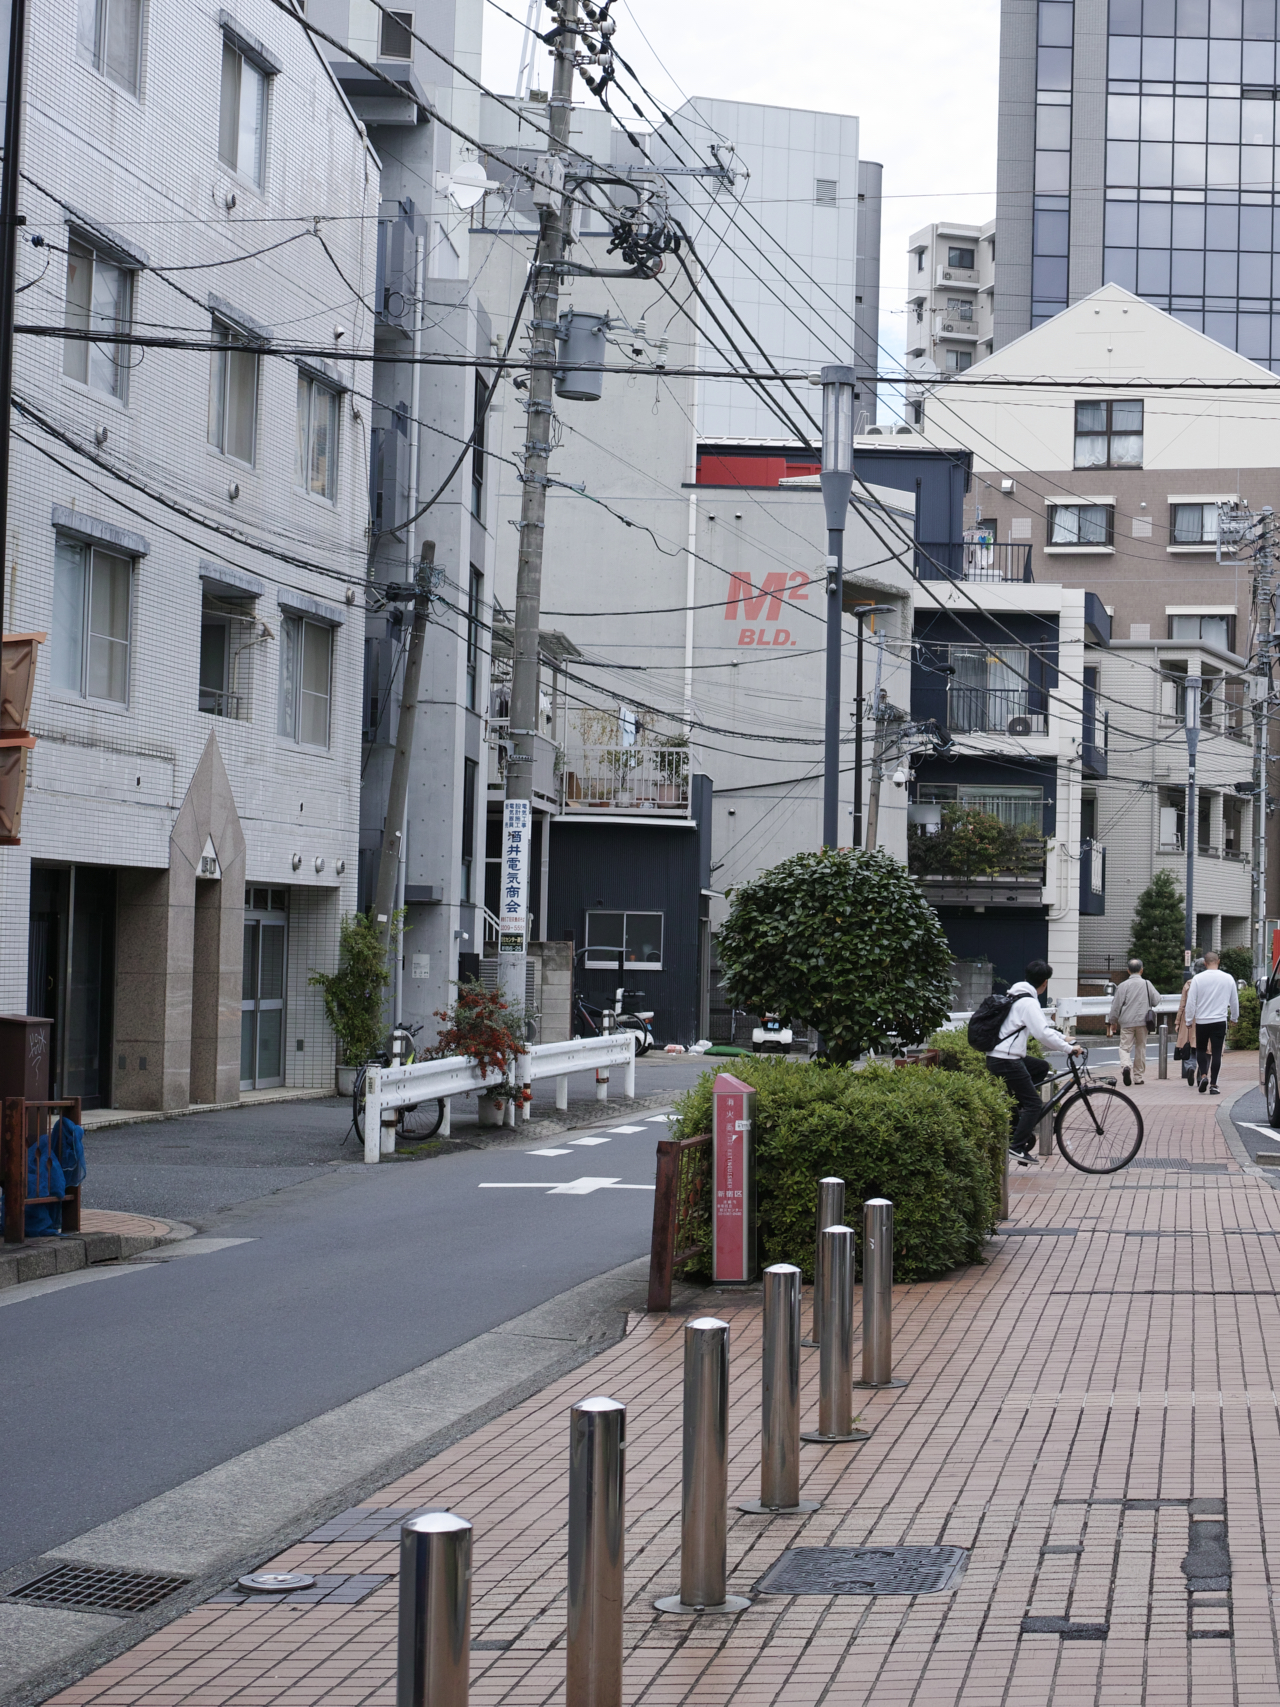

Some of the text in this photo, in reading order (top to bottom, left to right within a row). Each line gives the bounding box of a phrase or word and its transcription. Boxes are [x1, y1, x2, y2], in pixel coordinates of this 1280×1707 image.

[737, 628, 798, 646] BLD.
[504, 831, 522, 914] 酒井電気商会
[726, 1097, 735, 1131] 消火器
[717, 1190, 743, 1198] 新宿区
